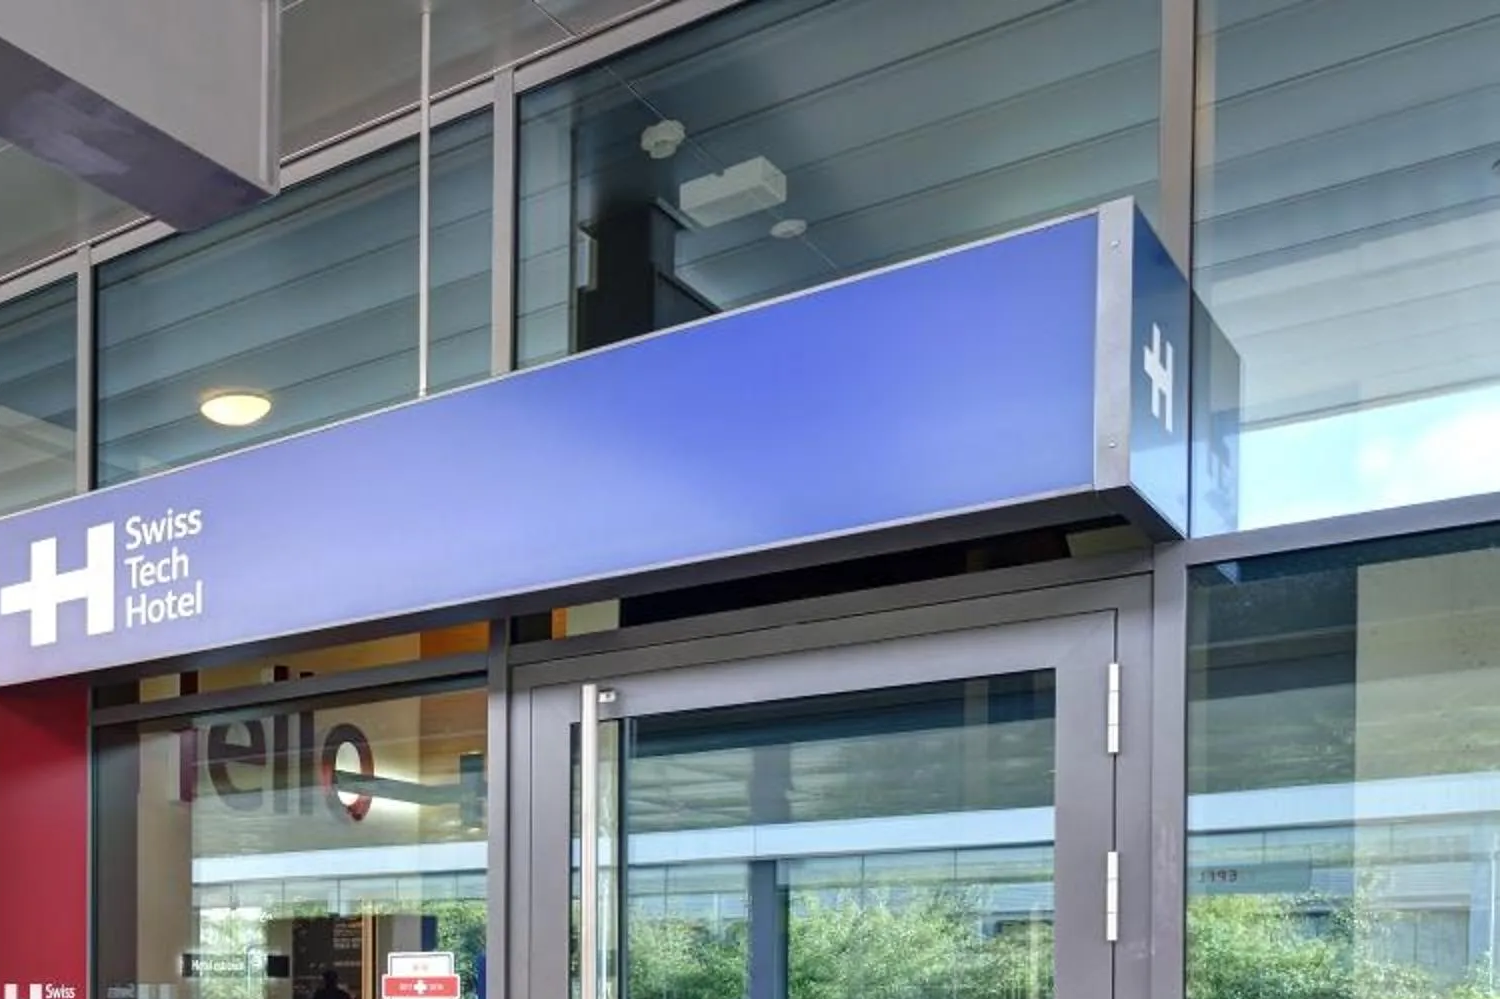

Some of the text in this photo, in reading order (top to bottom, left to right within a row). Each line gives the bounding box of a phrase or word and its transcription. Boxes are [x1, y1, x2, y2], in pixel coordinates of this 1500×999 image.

[125, 508, 203, 550] Swiss
[124, 546, 189, 589] Tech
[125, 580, 203, 628] Hotel
[45, 983, 76, 999] Swiss
